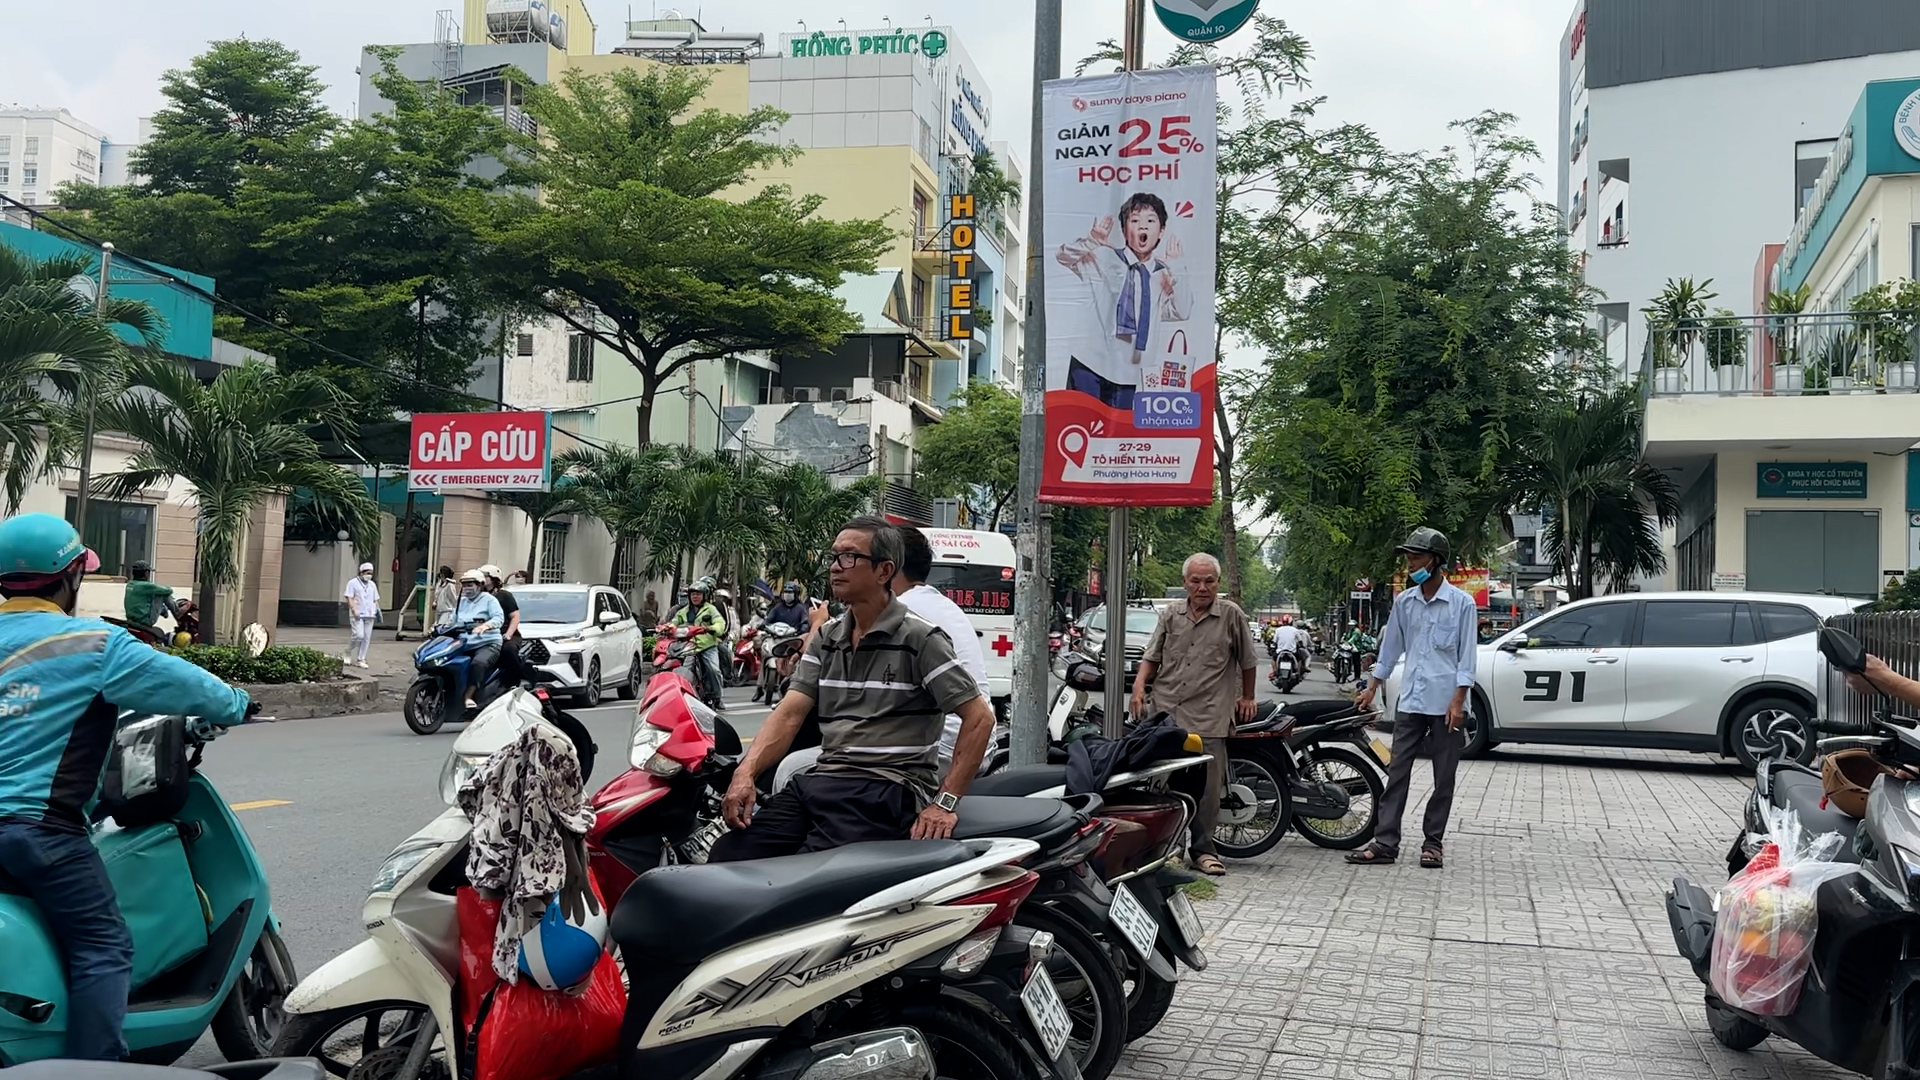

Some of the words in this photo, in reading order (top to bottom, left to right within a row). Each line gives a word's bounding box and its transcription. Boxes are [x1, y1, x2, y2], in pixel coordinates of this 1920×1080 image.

[1187, 26, 1212, 37] QUẬN
[1214, 25, 1225, 33] 10
[791, 30, 852, 58] HỒNG
[858, 27, 918, 55] PHÚC
[1089, 96, 1123, 107] sunny
[1124, 94, 1152, 105] days
[1154, 91, 1186, 103] piano
[1057, 122, 1110, 141] GIẢM
[1118, 115, 1204, 158] 25%
[1055, 144, 1113, 160] NGAY
[1078, 165, 1132, 186] HỌC
[1138, 159, 1180, 181] PHÍ
[952, 194, 974, 338] HOTEL
[1141, 396, 1193, 414] 100%
[1141, 415, 1169, 427] nhận
[1171, 415, 1193, 426] quà
[418, 420, 472, 463] CẤP
[481, 423, 536, 462] CỨU
[1119, 443, 1151, 451] 27-29
[1092, 454, 1106, 464] TÔ
[1109, 452, 1135, 464] HIẾN
[1138, 454, 1180, 464] THÀNH
[441, 474, 509, 484] EMERGENCY
[512, 474, 539, 484] 24/7
[1093, 469, 1128, 480] Phường
[1130, 470, 1149, 478] Hòa
[1151, 470, 1177, 479] Hưng
[1811, 470, 1825, 478] HỌC
[1523, 670, 1586, 702] 91
[1132, 912, 1154, 952] 9274
[658, 1019, 695, 1035] PGM-FI
